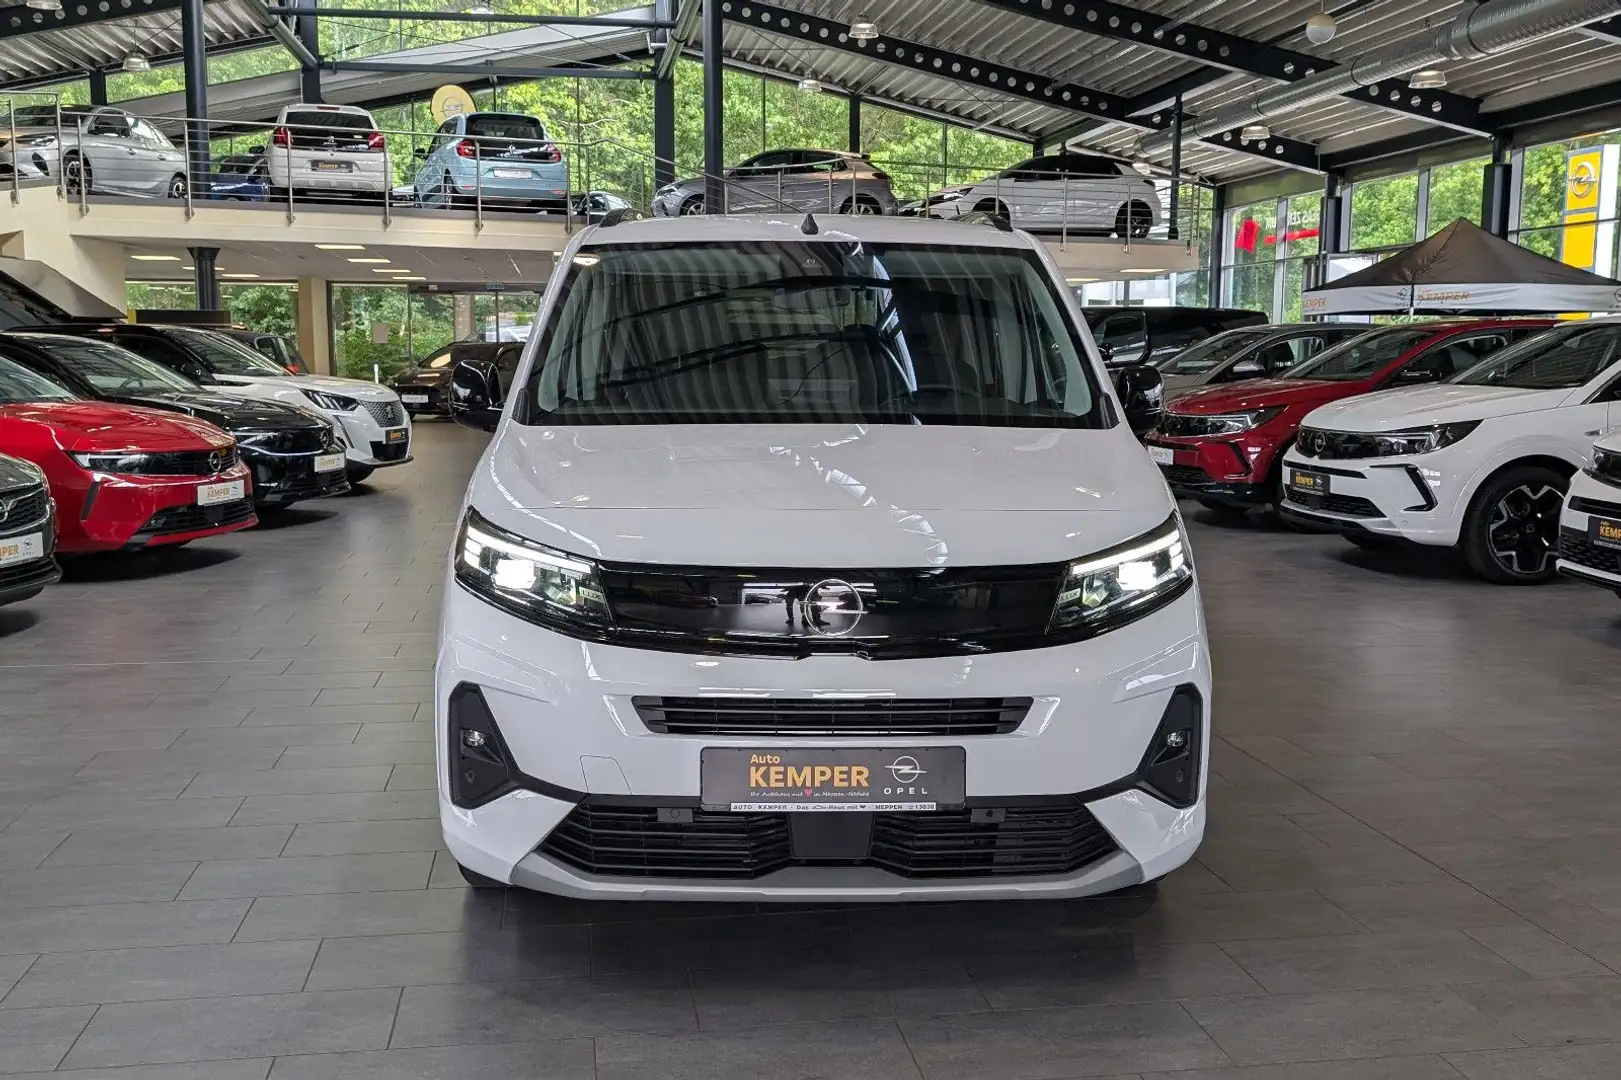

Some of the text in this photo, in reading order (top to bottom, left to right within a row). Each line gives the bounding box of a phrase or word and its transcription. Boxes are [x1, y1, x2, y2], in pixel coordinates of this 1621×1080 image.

[750, 754, 781, 764] Auto
[749, 765, 870, 788] KEMPER
[883, 787, 928, 795] OPEL
